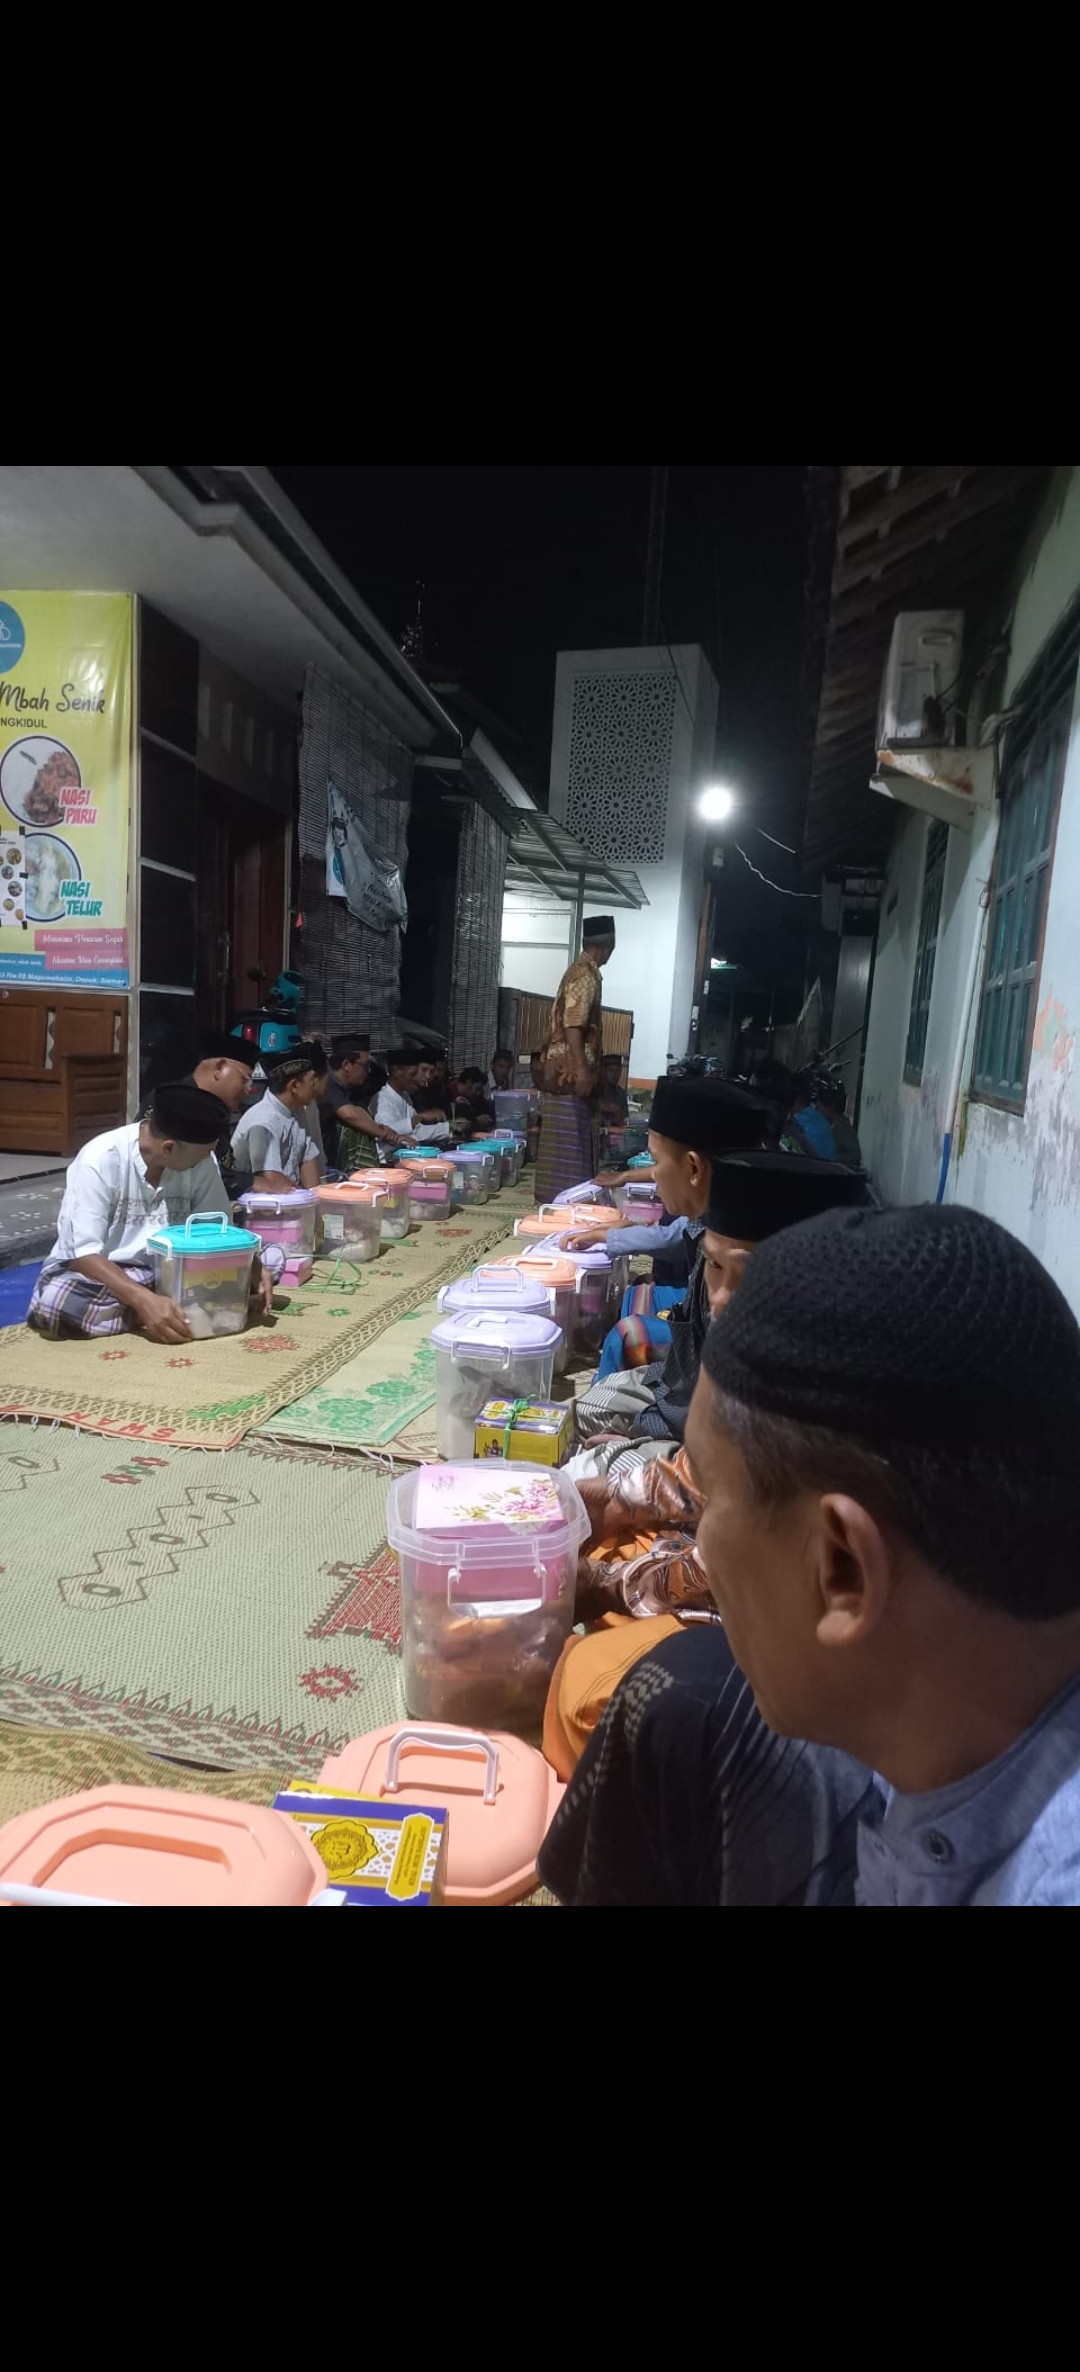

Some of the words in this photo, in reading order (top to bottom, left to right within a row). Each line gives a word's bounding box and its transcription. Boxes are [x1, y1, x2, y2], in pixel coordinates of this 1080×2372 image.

[0, 681, 49, 712] Mbah
[56, 683, 105, 713] Senik
[0, 717, 48, 729] NGKIDUL
[61, 789, 91, 806] NASI
[65, 808, 97, 824] PARU
[61, 881, 90, 898] NASI
[66, 900, 103, 916] TELUR
